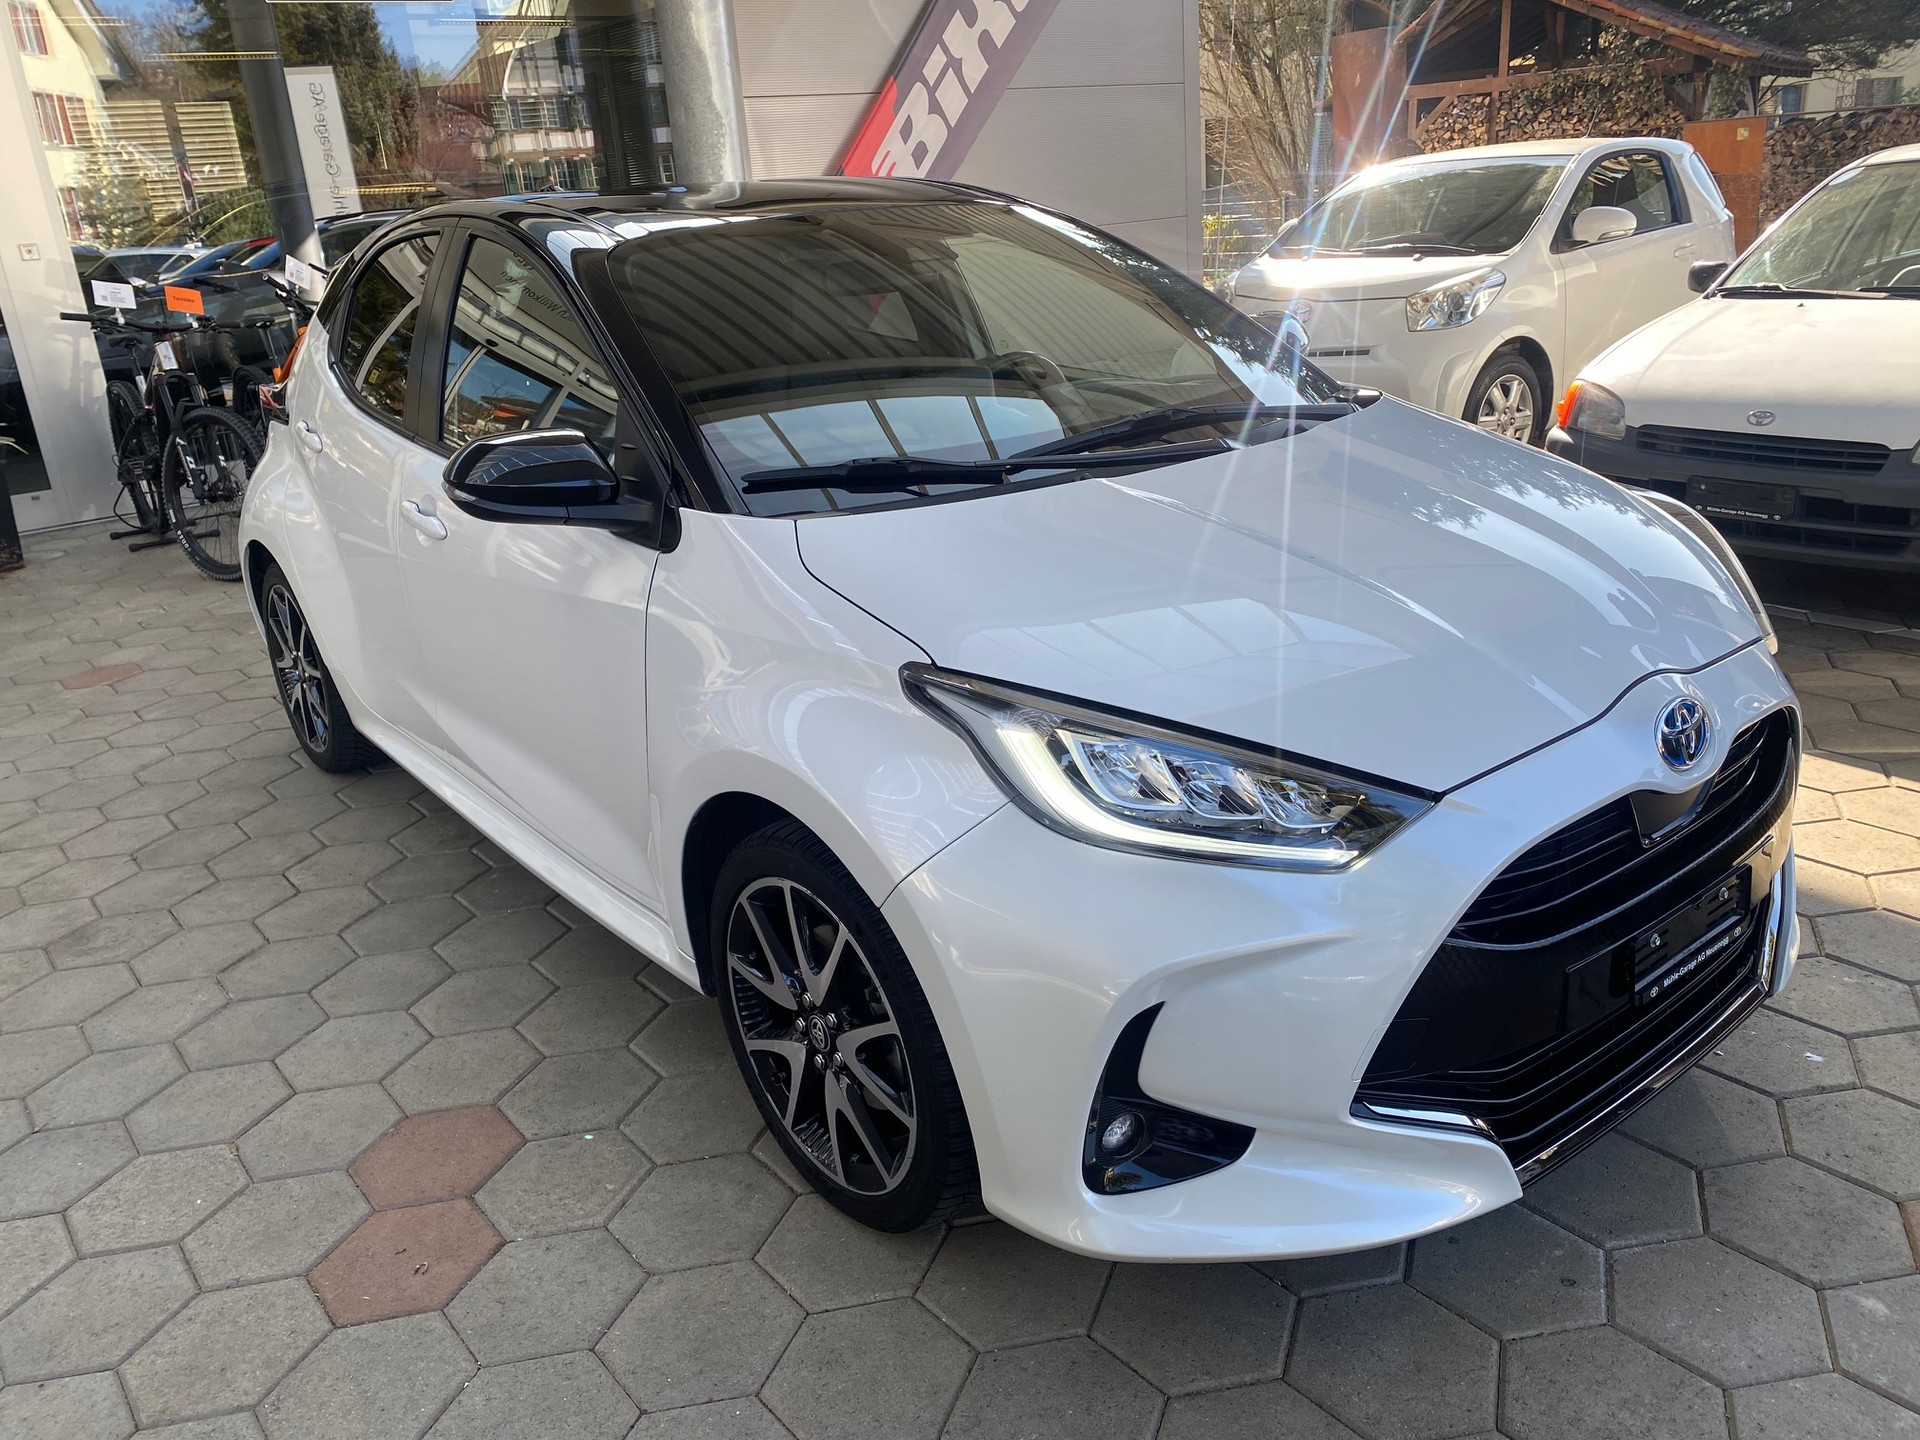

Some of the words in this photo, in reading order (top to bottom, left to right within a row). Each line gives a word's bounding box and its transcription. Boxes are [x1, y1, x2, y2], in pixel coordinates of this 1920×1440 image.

[871, 0, 1030, 178] BiX
[1663, 959, 1697, 988] Mühle-Garage
[1697, 952, 1706, 963] AG
[1705, 936, 1730, 957] Neuenegg
